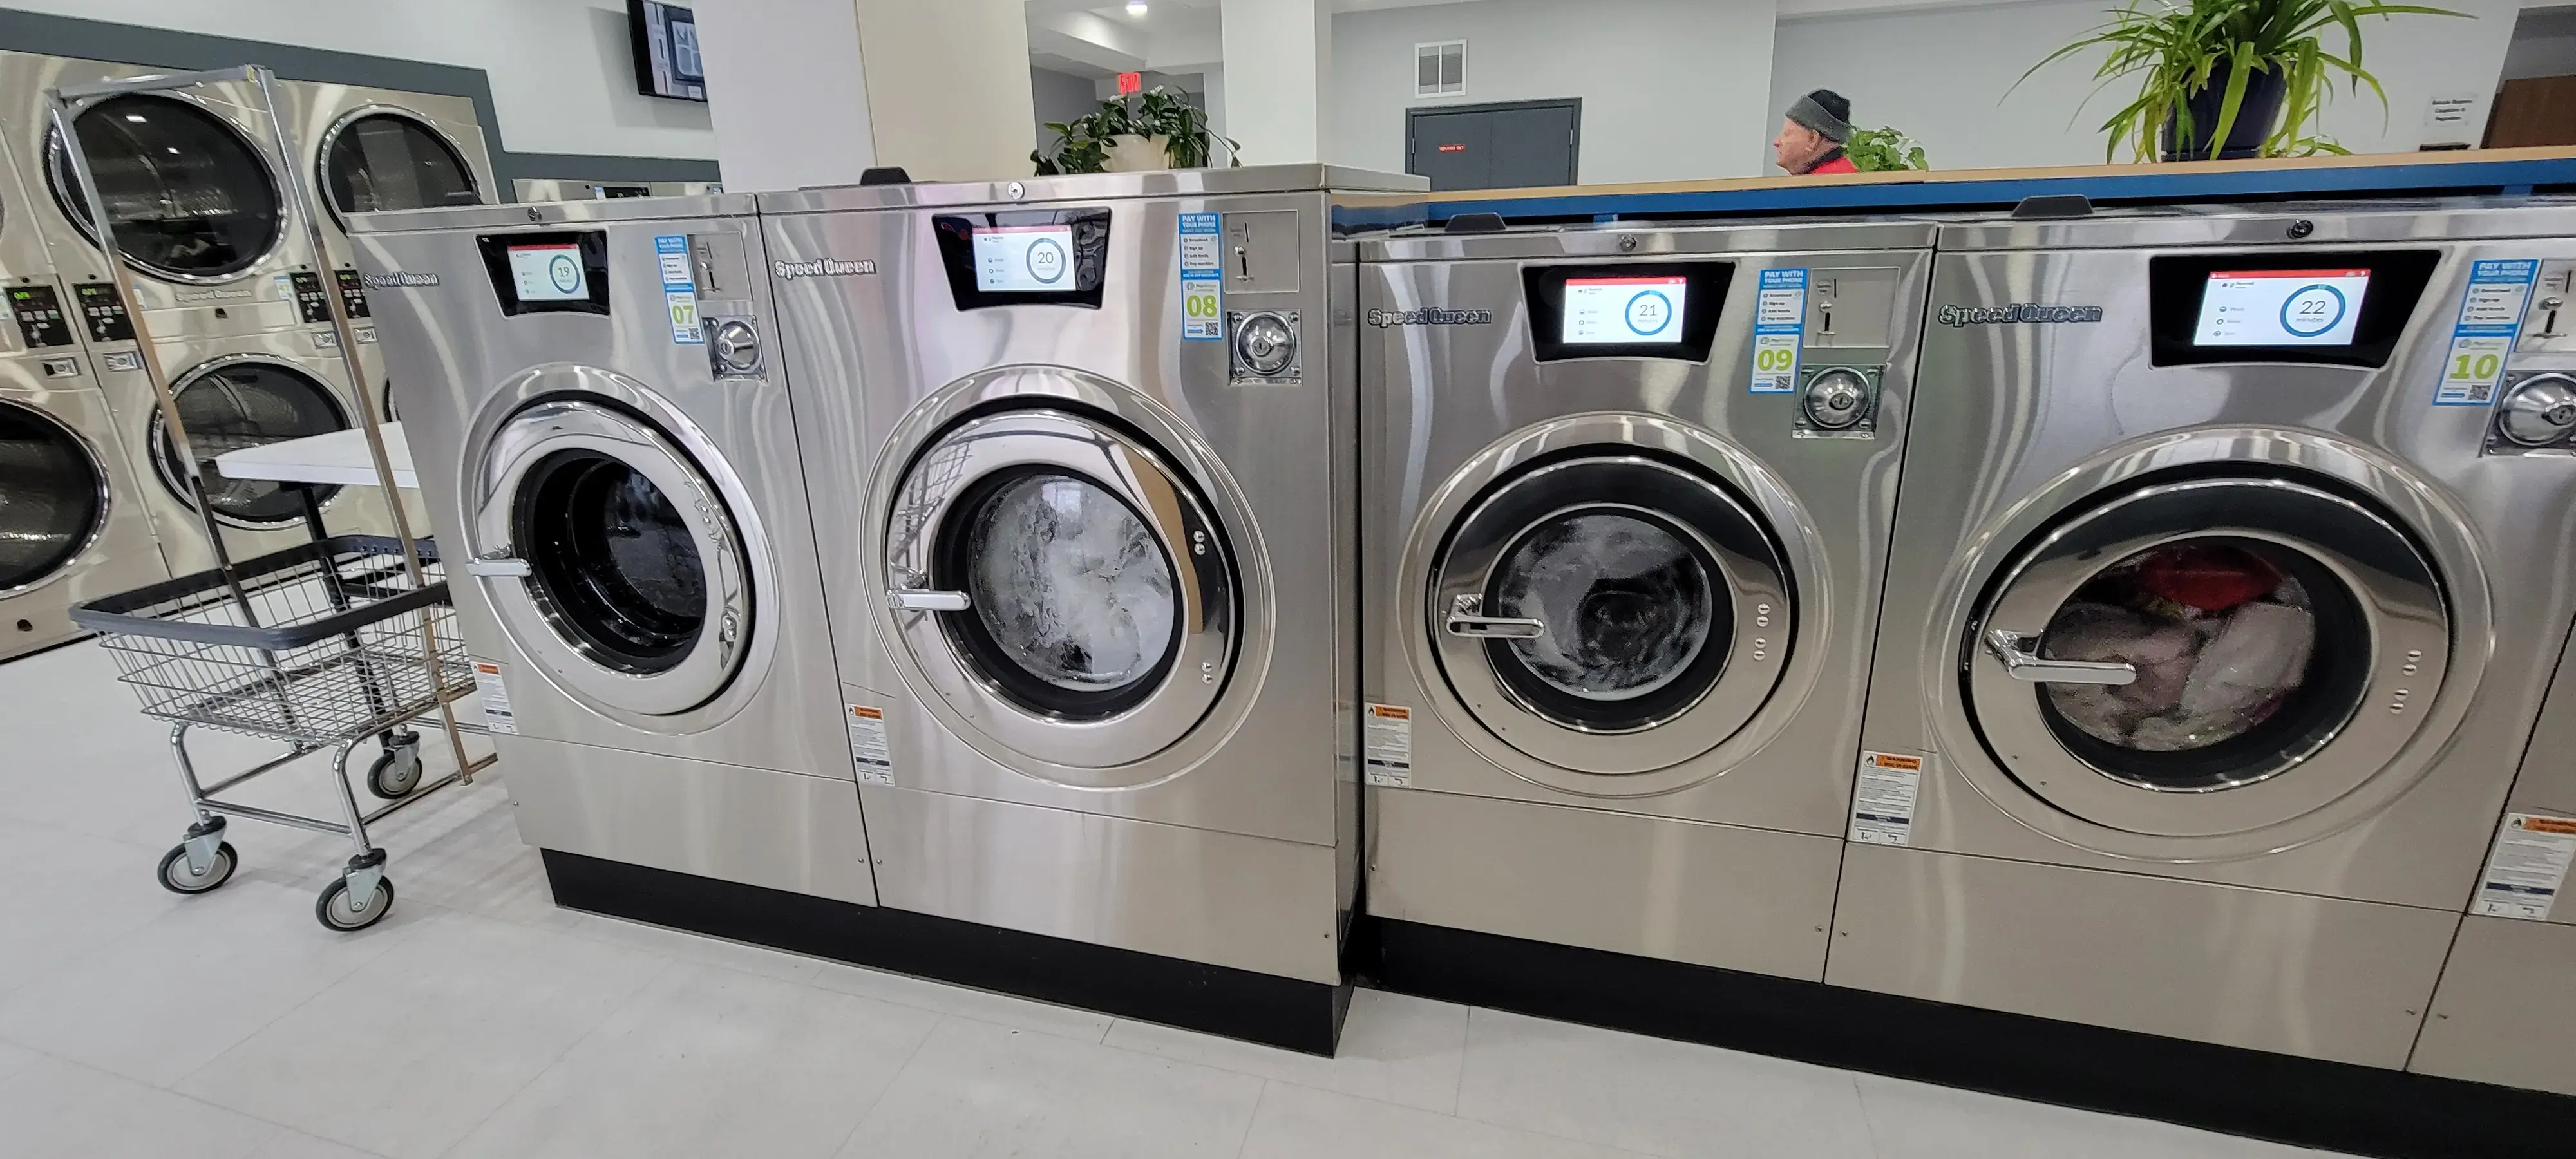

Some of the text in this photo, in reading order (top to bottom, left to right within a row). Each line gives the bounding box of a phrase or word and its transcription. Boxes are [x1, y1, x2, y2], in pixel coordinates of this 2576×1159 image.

[1037, 252, 1054, 264] 20
[558, 267, 569, 277] 19
[775, 258, 877, 281] Speed Queen
[672, 305, 694, 324] 07
[1187, 295, 1217, 317] 08
[1639, 305, 1658, 316] 21
[1938, 303, 2103, 328] Speed Queen
[2300, 301, 2326, 314] 22
[1368, 307, 1492, 328] Speed Queen
[1757, 348, 1793, 371] 09
[2449, 354, 2499, 380] 10
